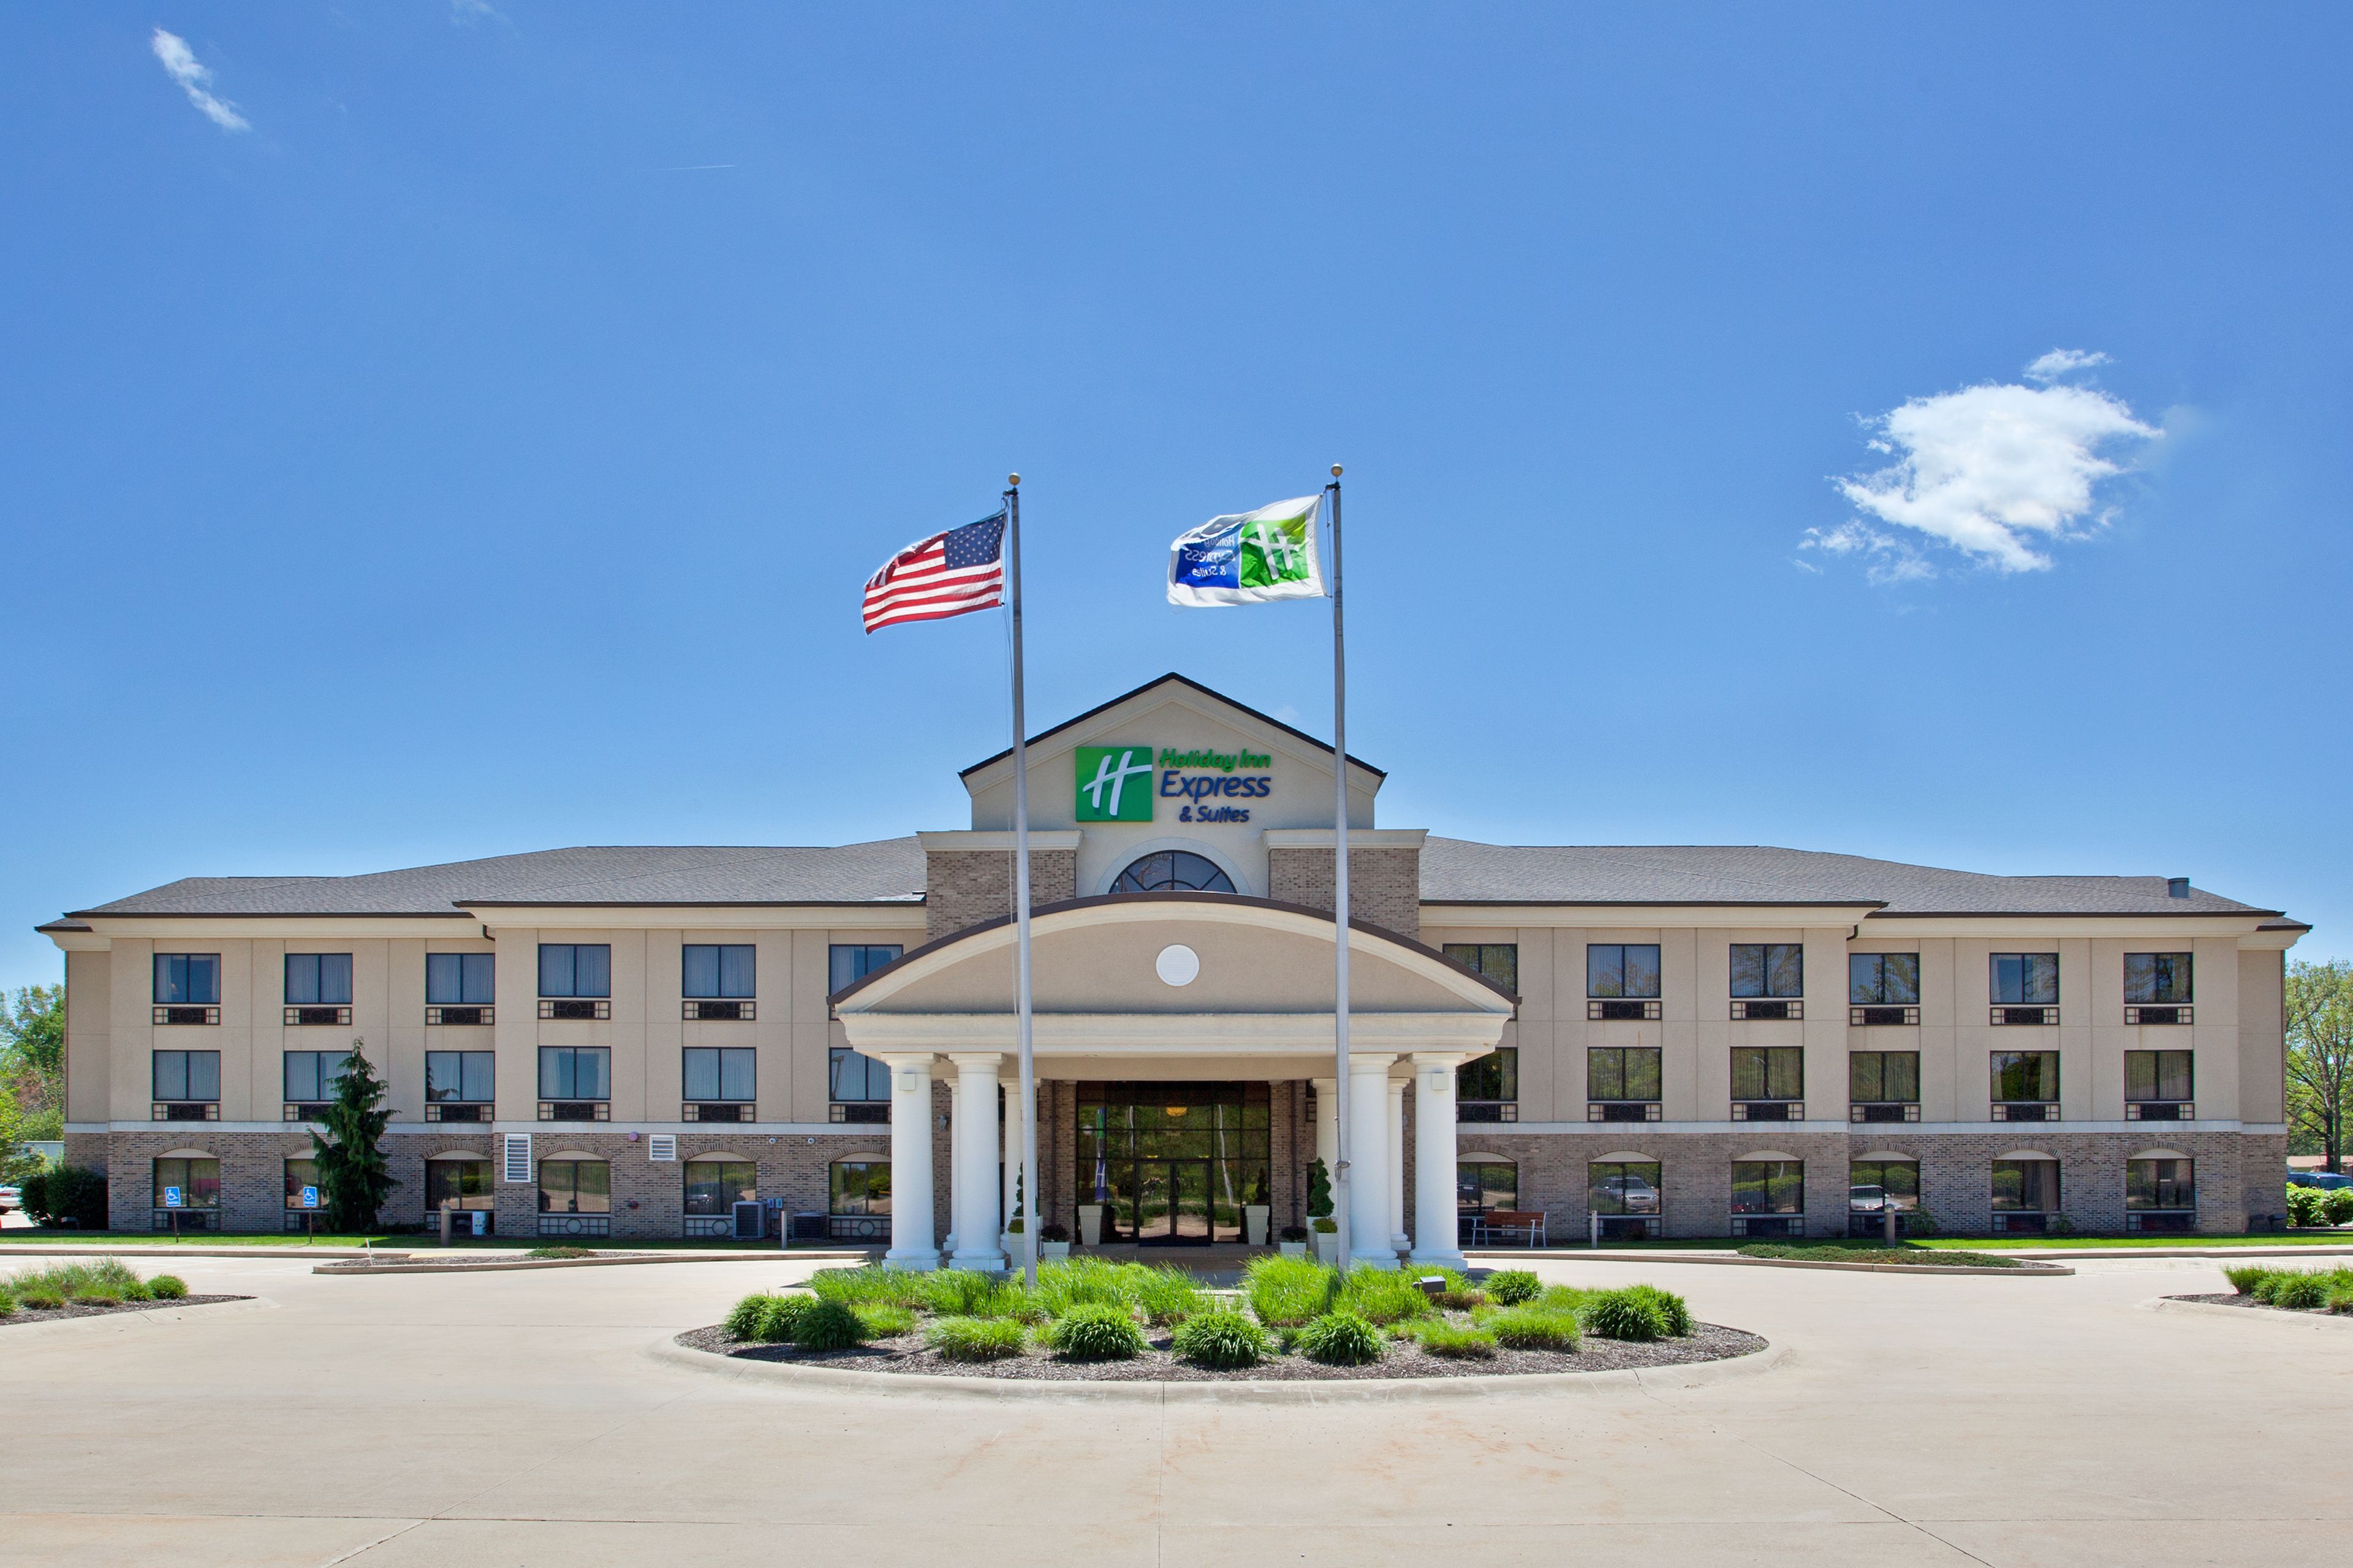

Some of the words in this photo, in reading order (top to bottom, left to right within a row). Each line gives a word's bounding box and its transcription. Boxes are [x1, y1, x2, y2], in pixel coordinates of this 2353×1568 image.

[1159, 748, 1237, 772] Holiday
[1240, 748, 1271, 768] Inn
[1160, 770, 1271, 804] Express
[1178, 806, 1192, 823] &
[1195, 805, 1250, 823] Suites
